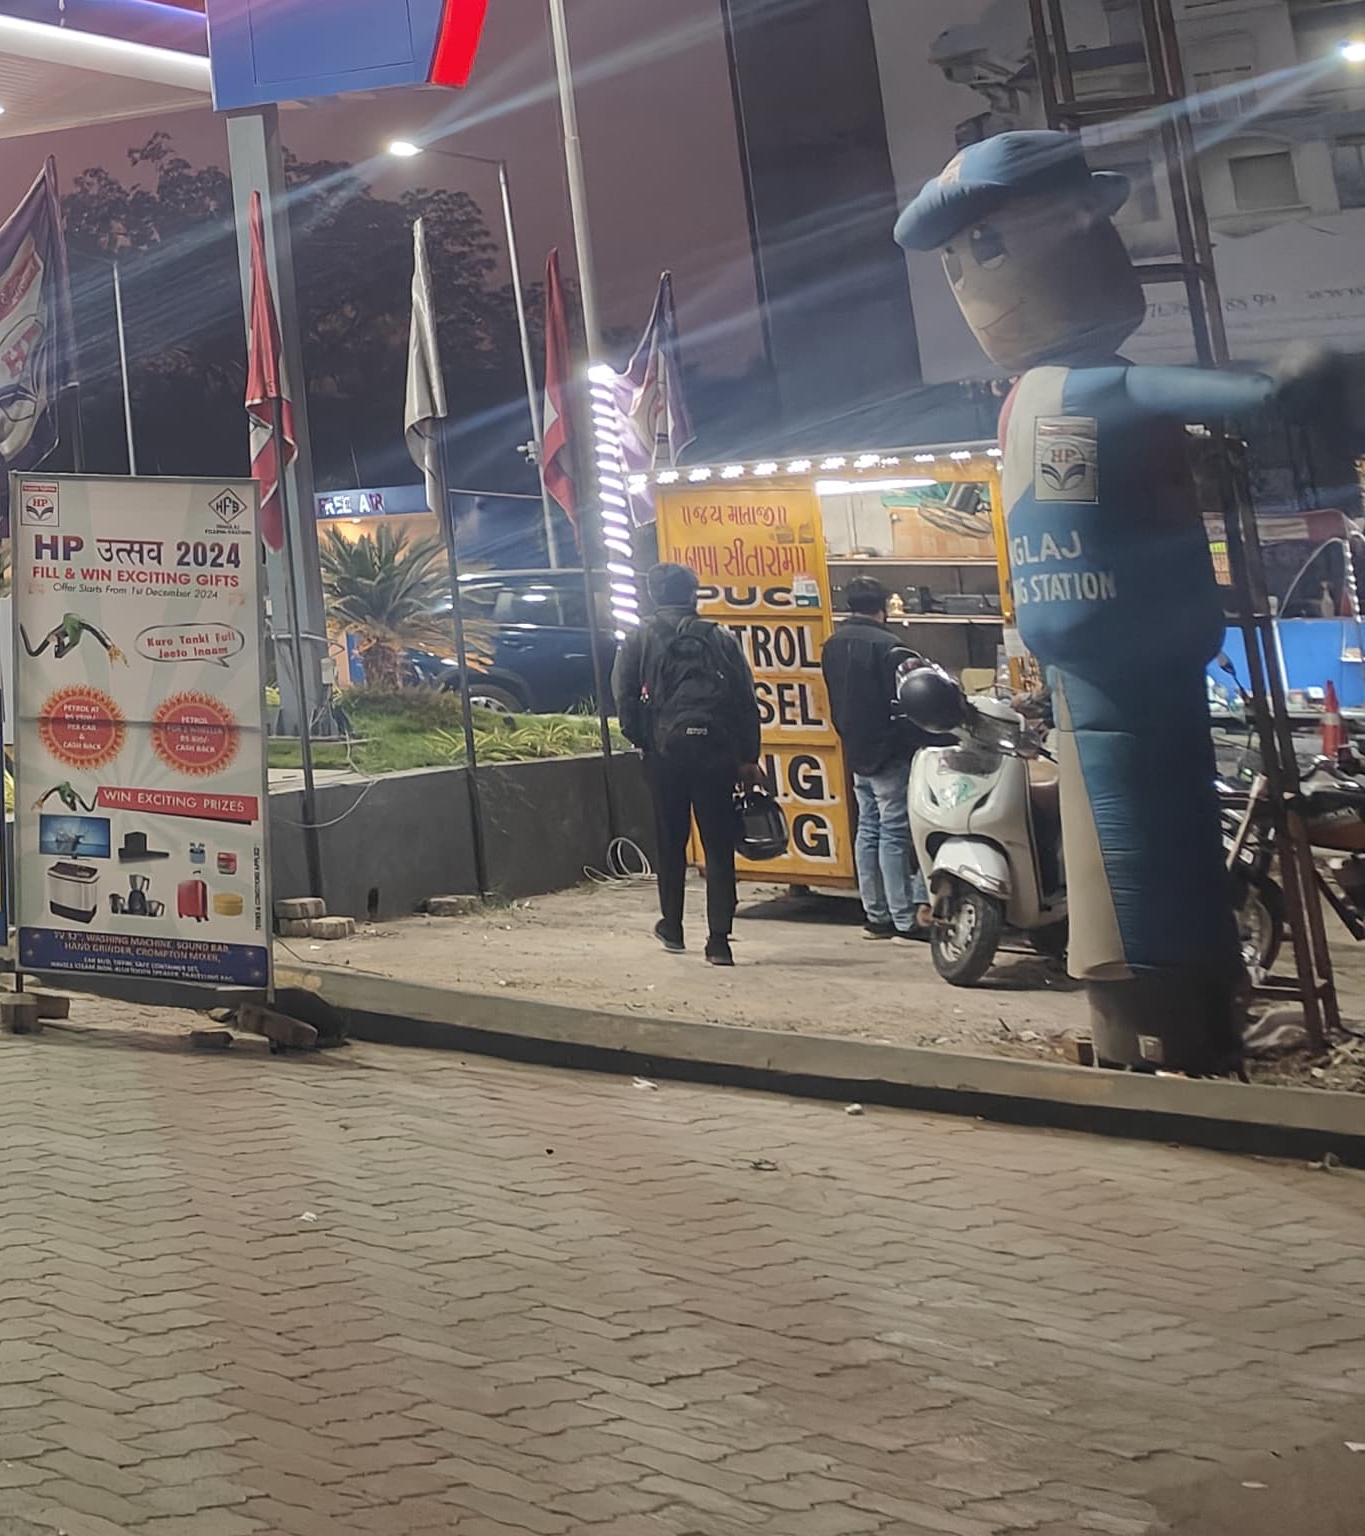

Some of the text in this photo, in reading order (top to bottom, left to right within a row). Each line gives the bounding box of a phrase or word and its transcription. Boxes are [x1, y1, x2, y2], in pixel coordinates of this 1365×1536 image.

[1049, 448, 1077, 464] HP
[32, 498, 49, 508] HP
[33, 533, 242, 569] HP उत्सव 2024
[1011, 530, 1083, 567] GLAJ
[32, 566, 240, 588] FILL & WIN EXCITING GIFTS
[1030, 571, 1118, 603] STATION
[52, 582, 219, 600] Offer Starts From 1st December 2024
[730, 624, 822, 669] TROL
[754, 681, 824, 727] SEL
[102, 790, 246, 813] WIN EXCITING PRIZES
[64, 941, 91, 952] HAND
[135, 947, 189, 960] CROMPTON
[85, 933, 129, 946] WASHING
[176, 941, 210, 952] SOUND
